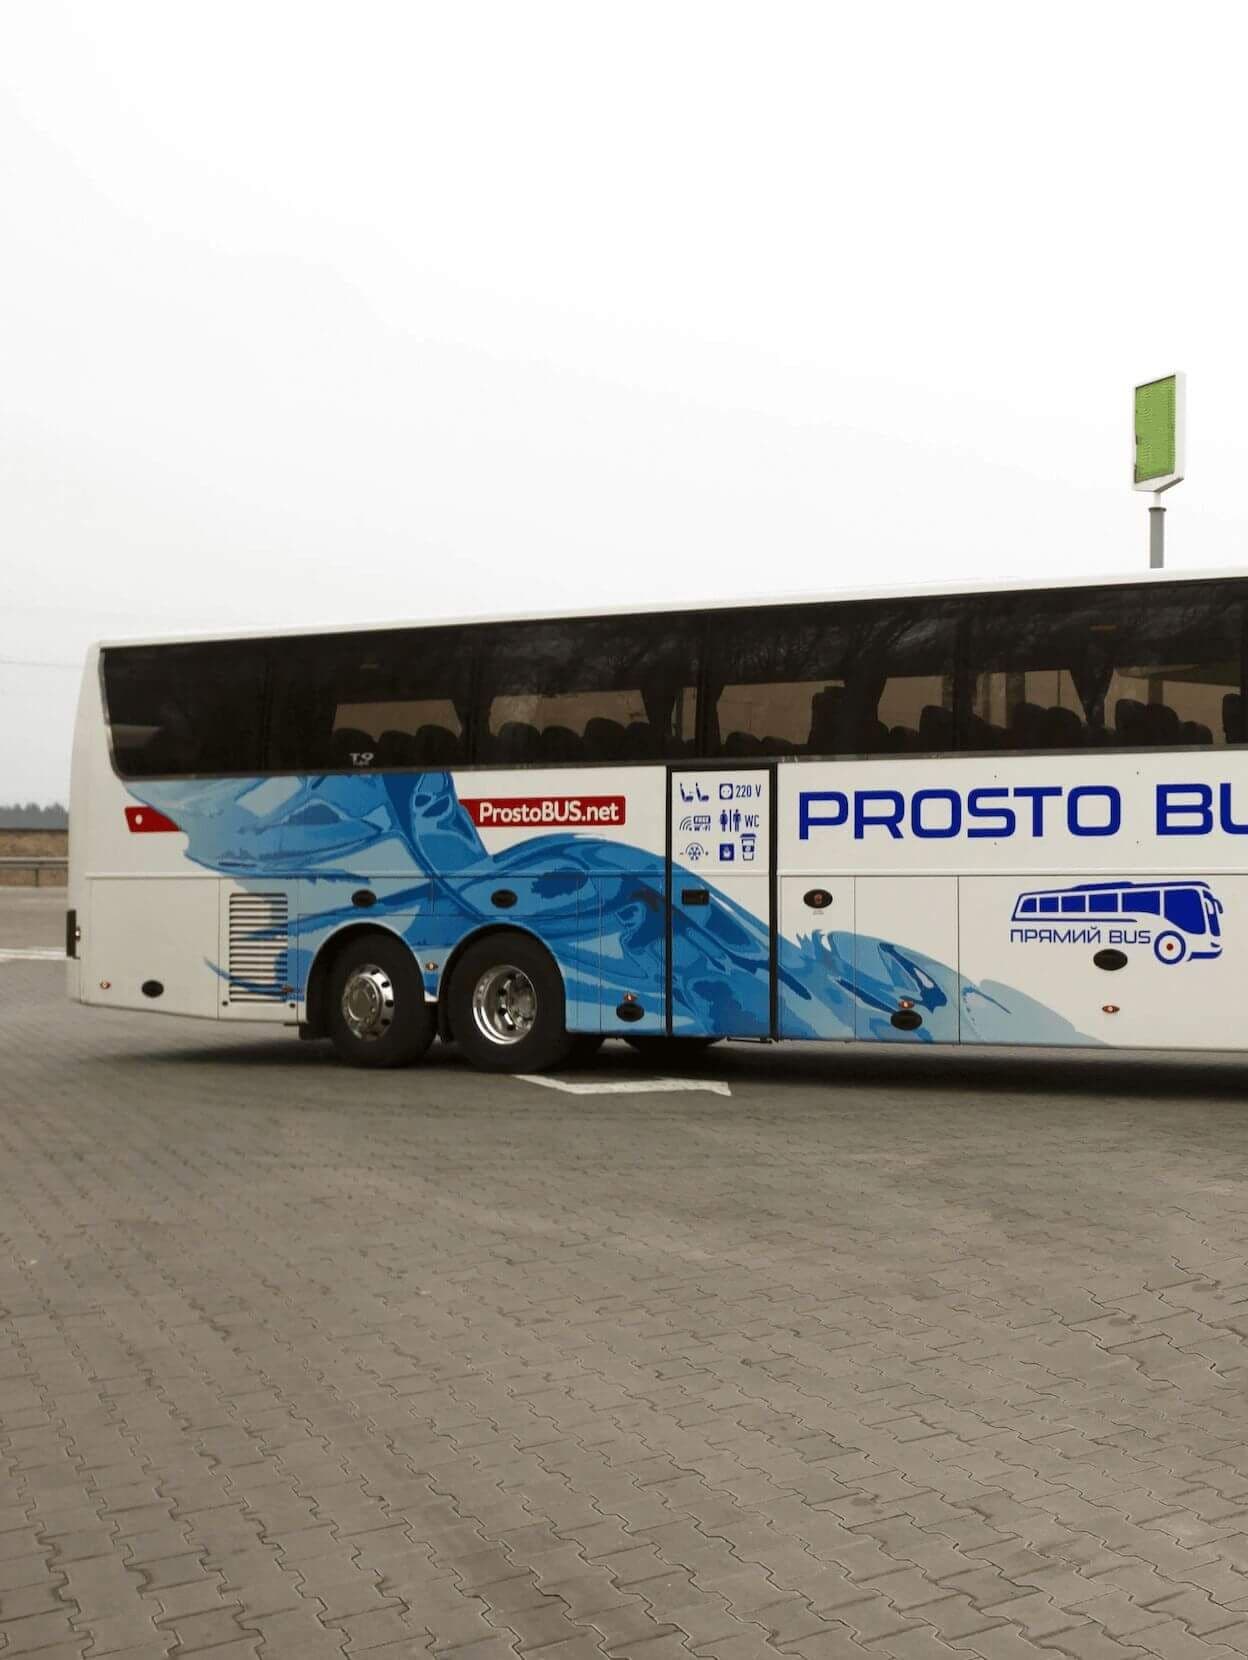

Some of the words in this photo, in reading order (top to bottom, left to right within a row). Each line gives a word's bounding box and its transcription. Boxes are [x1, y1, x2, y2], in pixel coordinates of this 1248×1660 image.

[735, 785, 752, 798] 220
[755, 784, 762, 797] V
[479, 801, 619, 823] ProstoBUS.net
[744, 814, 760, 828] WC
[799, 785, 1121, 840] PROSTO
[1010, 926, 1101, 943] ПРЯМИЙ
[1109, 930, 1151, 944] BUS
